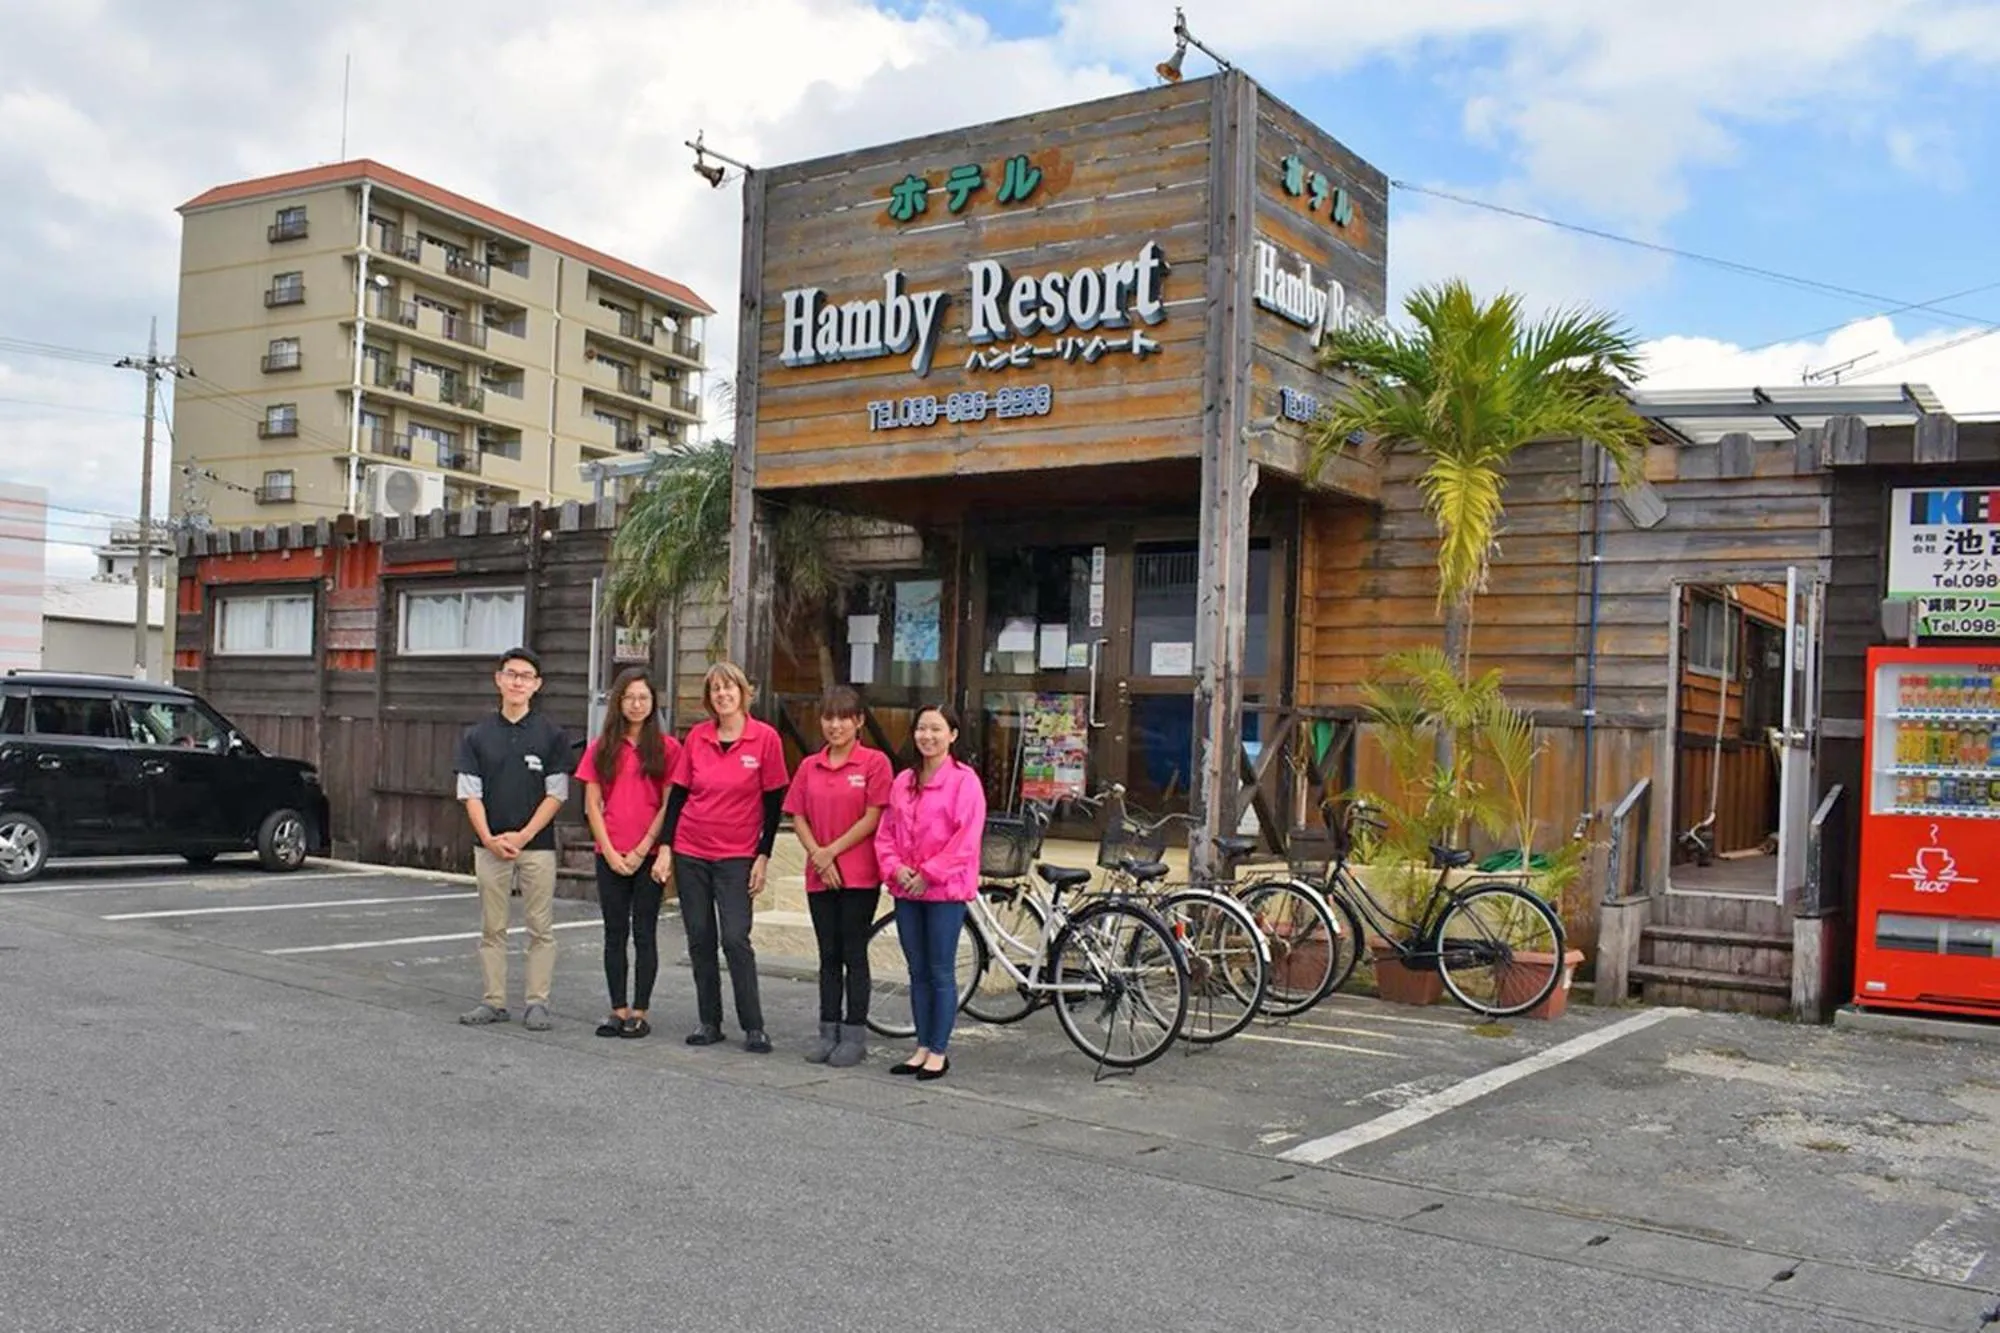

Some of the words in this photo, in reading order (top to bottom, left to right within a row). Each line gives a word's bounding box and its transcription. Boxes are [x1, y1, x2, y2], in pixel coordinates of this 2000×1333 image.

[888, 154, 1042, 222] ホテル
[779, 270, 945, 376] Hamby
[967, 241, 1166, 340] Resort
[1252, 239, 1328, 348] Hamby
[1910, 489, 2000, 525] IKE
